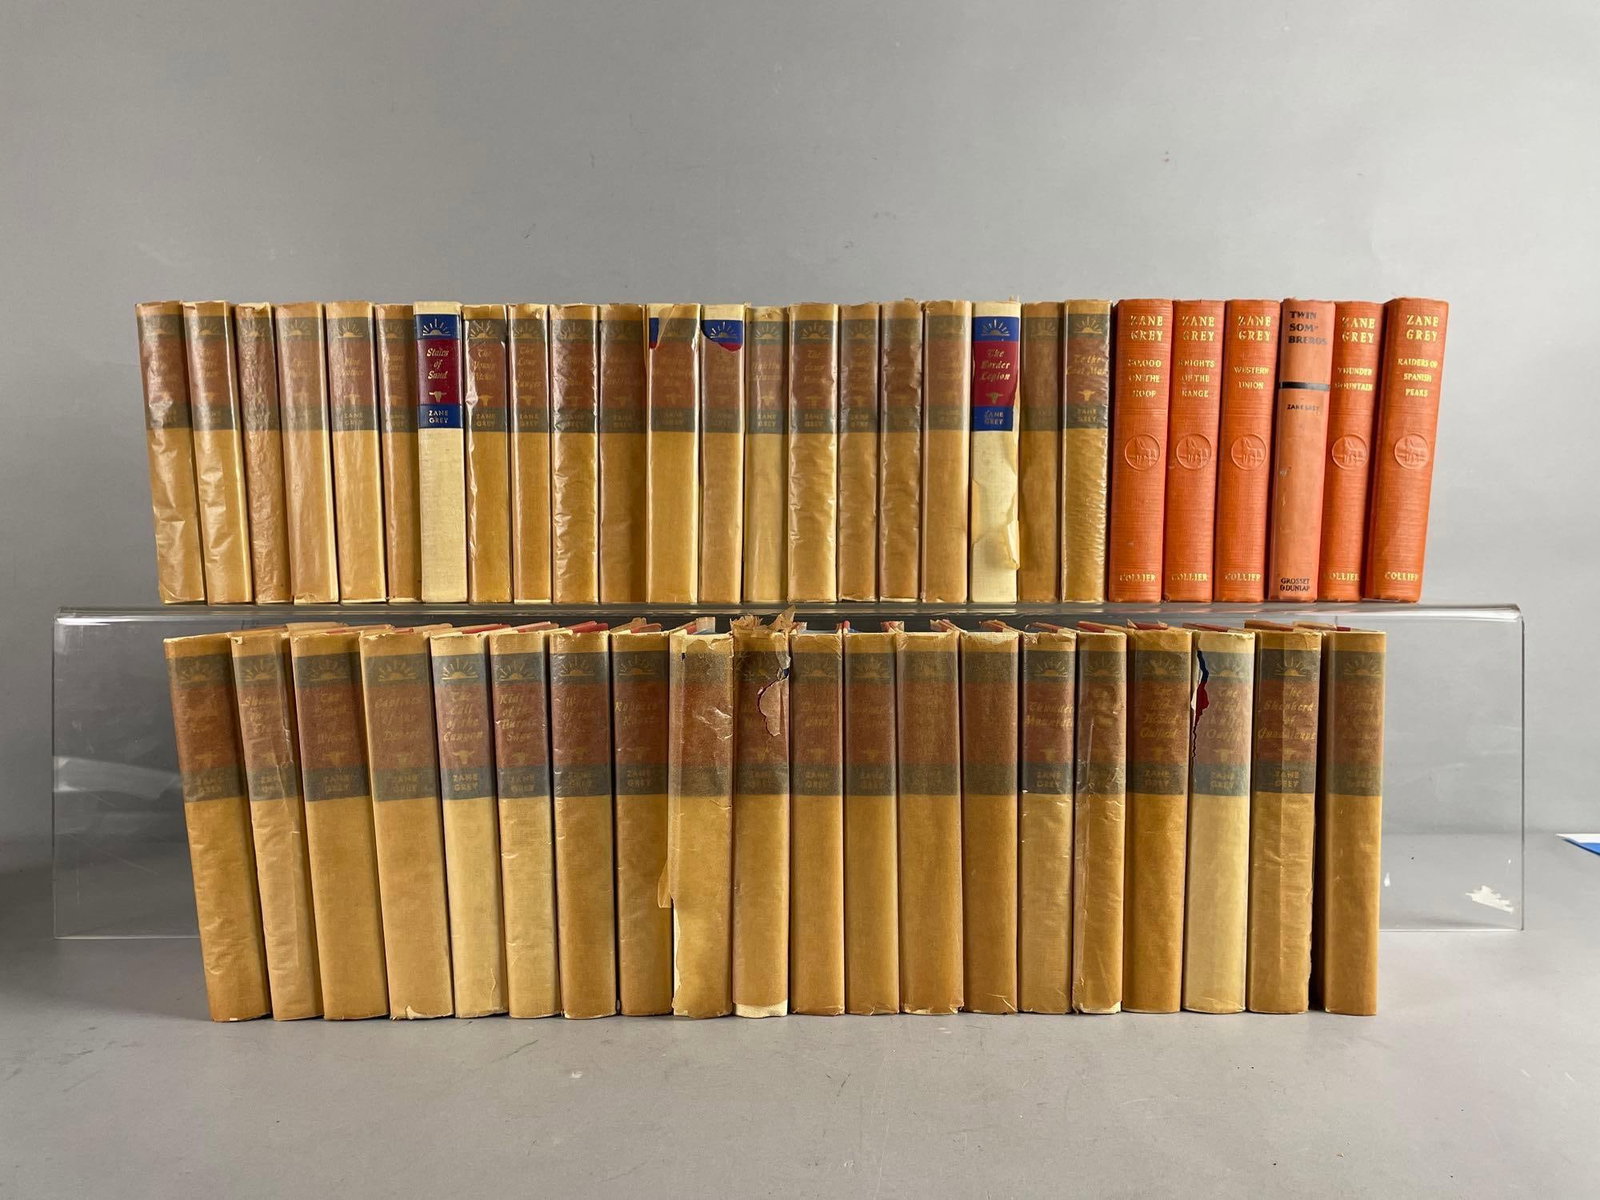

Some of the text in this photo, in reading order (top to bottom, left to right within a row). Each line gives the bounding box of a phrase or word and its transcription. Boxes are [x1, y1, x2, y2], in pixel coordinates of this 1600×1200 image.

[1289, 311, 1317, 319] TWIN
[1130, 315, 1163, 326] ZANE
[1182, 315, 1216, 326] ZANE
[1238, 316, 1272, 327] ZANE
[1342, 317, 1376, 329] ZANE
[1406, 315, 1439, 328] ZANE
[1130, 330, 1163, 341] GREY
[1183, 330, 1215, 341] GREY
[1238, 330, 1271, 342] GREY
[1342, 332, 1375, 344] GREY
[1406, 329, 1438, 342] GREY
[1288, 336, 1328, 345] BREROS
[426, 348, 449, 357] Stairs
[987, 349, 1005, 358] The
[433, 359, 443, 369] of
[981, 360, 1011, 370] Border
[1178, 359, 1216, 368] KNIGHTS
[1397, 358, 1438, 369] RAIDERS OF
[427, 370, 448, 380] Sand
[1233, 367, 1270, 375] WESTERN
[1338, 367, 1373, 376] THUNDER
[981, 372, 1011, 382] Legion
[1145, 374, 1161, 383] THE
[1181, 374, 1210, 383] OF THE
[1403, 373, 1432, 383] SPANISH
[1238, 381, 1265, 389] UNION
[1181, 389, 1209, 398] RANGE
[1405, 388, 1429, 397] PEAKS
[984, 409, 1003, 418] ZANE
[1119, 573, 1156, 582] COLLIER
[1171, 573, 1208, 582] COLLIER
[1225, 573, 1261, 582] COLLIER
[1280, 577, 1310, 585] GROSSET
[1329, 573, 1360, 582] OLLIER
[1385, 571, 1419, 582] COLLIER
[1263, 701, 1314, 712] Shepherd
[453, 774, 478, 782] ZANE
[454, 783, 478, 792] GREY
